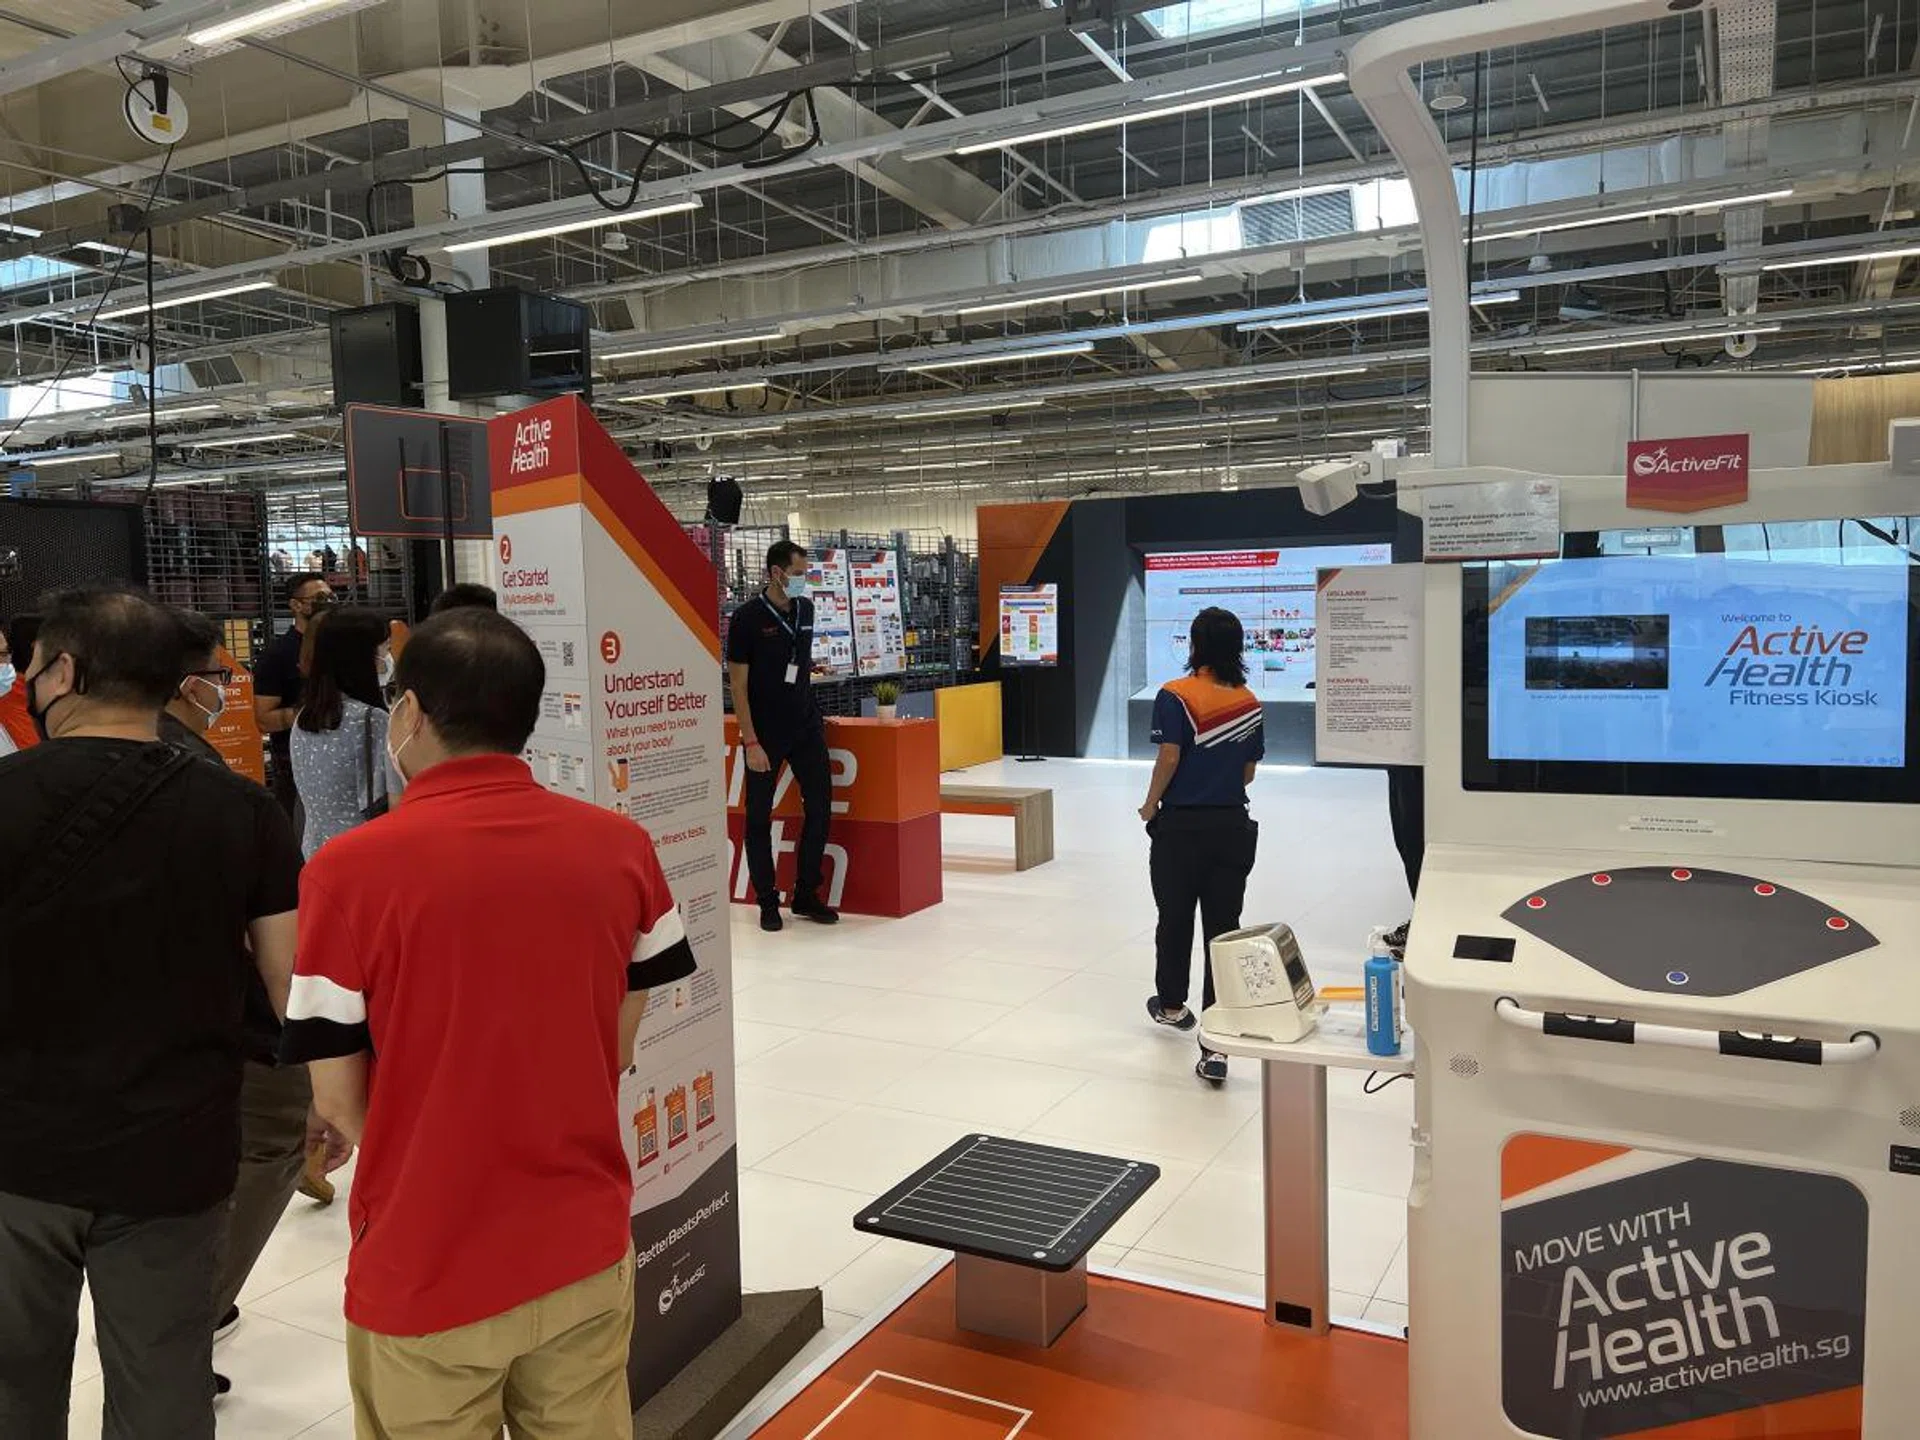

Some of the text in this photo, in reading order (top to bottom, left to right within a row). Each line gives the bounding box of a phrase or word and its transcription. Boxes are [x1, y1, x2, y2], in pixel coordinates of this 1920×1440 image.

[514, 417, 552, 447] Active
[510, 442, 549, 474] Health
[1655, 454, 1742, 473] ActiveFit
[502, 540, 510, 560] 2
[502, 567, 549, 588] Get Started
[1721, 613, 1792, 623] Welcome to
[605, 637, 617, 660] 3
[1725, 624, 1869, 655] Active
[604, 668, 685, 694] Understand
[1704, 656, 1853, 687] Health
[604, 694, 664, 720] Yourself
[667, 692, 707, 712] Better
[1729, 689, 1879, 706] Fitness Kiosk
[606, 717, 698, 740] What you need to know
[606, 743, 631, 757] about
[632, 740, 651, 755] your
[636, 1190, 730, 1269] BetterBeatsPerfect
[1515, 1201, 1691, 1273] MOVE WITH
[1558, 1231, 1776, 1328] Active
[1553, 1287, 1781, 1390] Health
[1577, 1334, 1851, 1409] www.activehealth.sg
